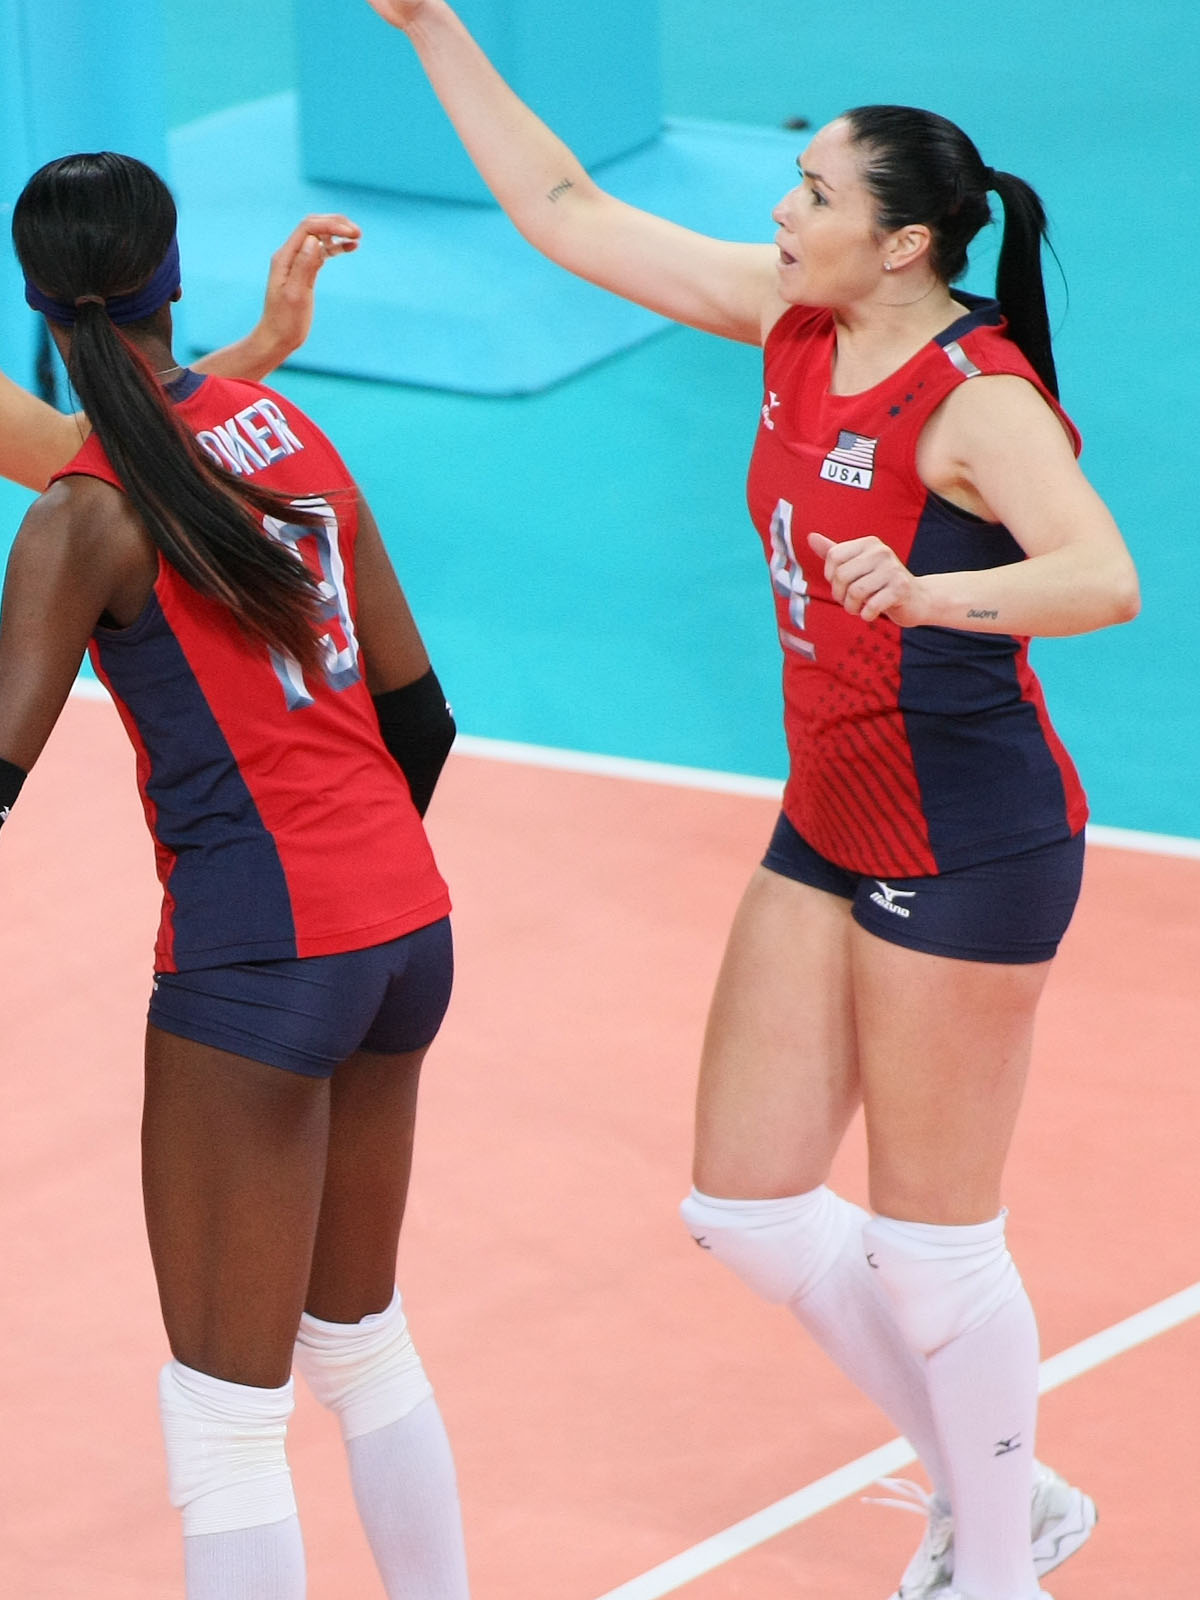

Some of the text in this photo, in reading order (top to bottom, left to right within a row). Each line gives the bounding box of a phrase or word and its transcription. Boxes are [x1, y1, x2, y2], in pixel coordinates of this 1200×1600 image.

[828, 464, 862, 485] USA
[262, 494, 362, 712] 9
[769, 498, 810, 631] 4
